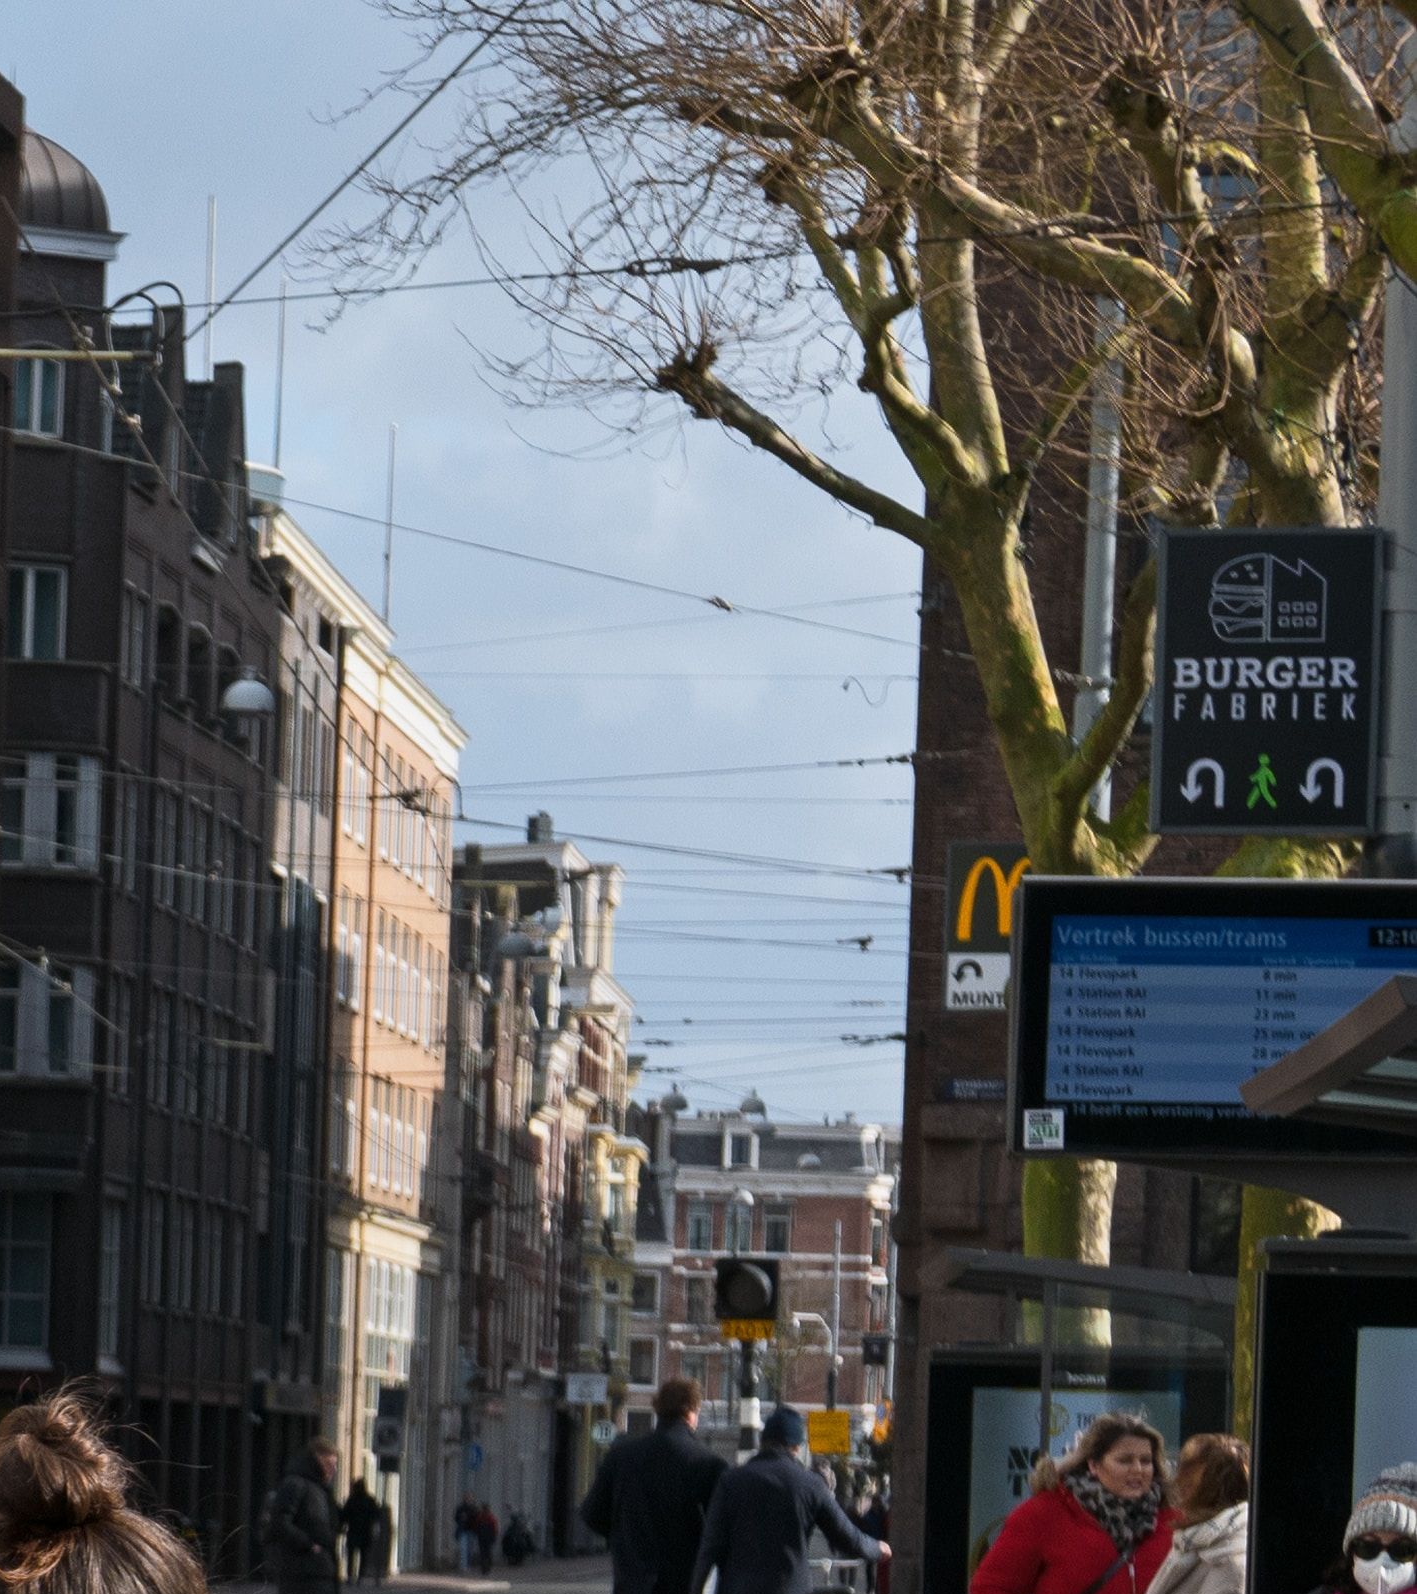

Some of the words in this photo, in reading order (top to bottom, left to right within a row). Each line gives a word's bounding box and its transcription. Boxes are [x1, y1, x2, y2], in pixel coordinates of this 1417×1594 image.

[1173, 656, 1358, 689] BURGER
[1173, 692, 1356, 721] FABRIEK
[1057, 924, 1136, 947] Vertrek
[1145, 925, 1287, 949] bussen/trams
[1079, 967, 1138, 983] Flevopark
[1078, 987, 1121, 1000] Station
[1077, 1006, 1121, 1020] Station
[1076, 1025, 1135, 1041] Flevopark
[1076, 1045, 1135, 1060] Flevopark
[1074, 1064, 1119, 1078] Station
[1074, 1083, 1133, 1098] Flevopark
